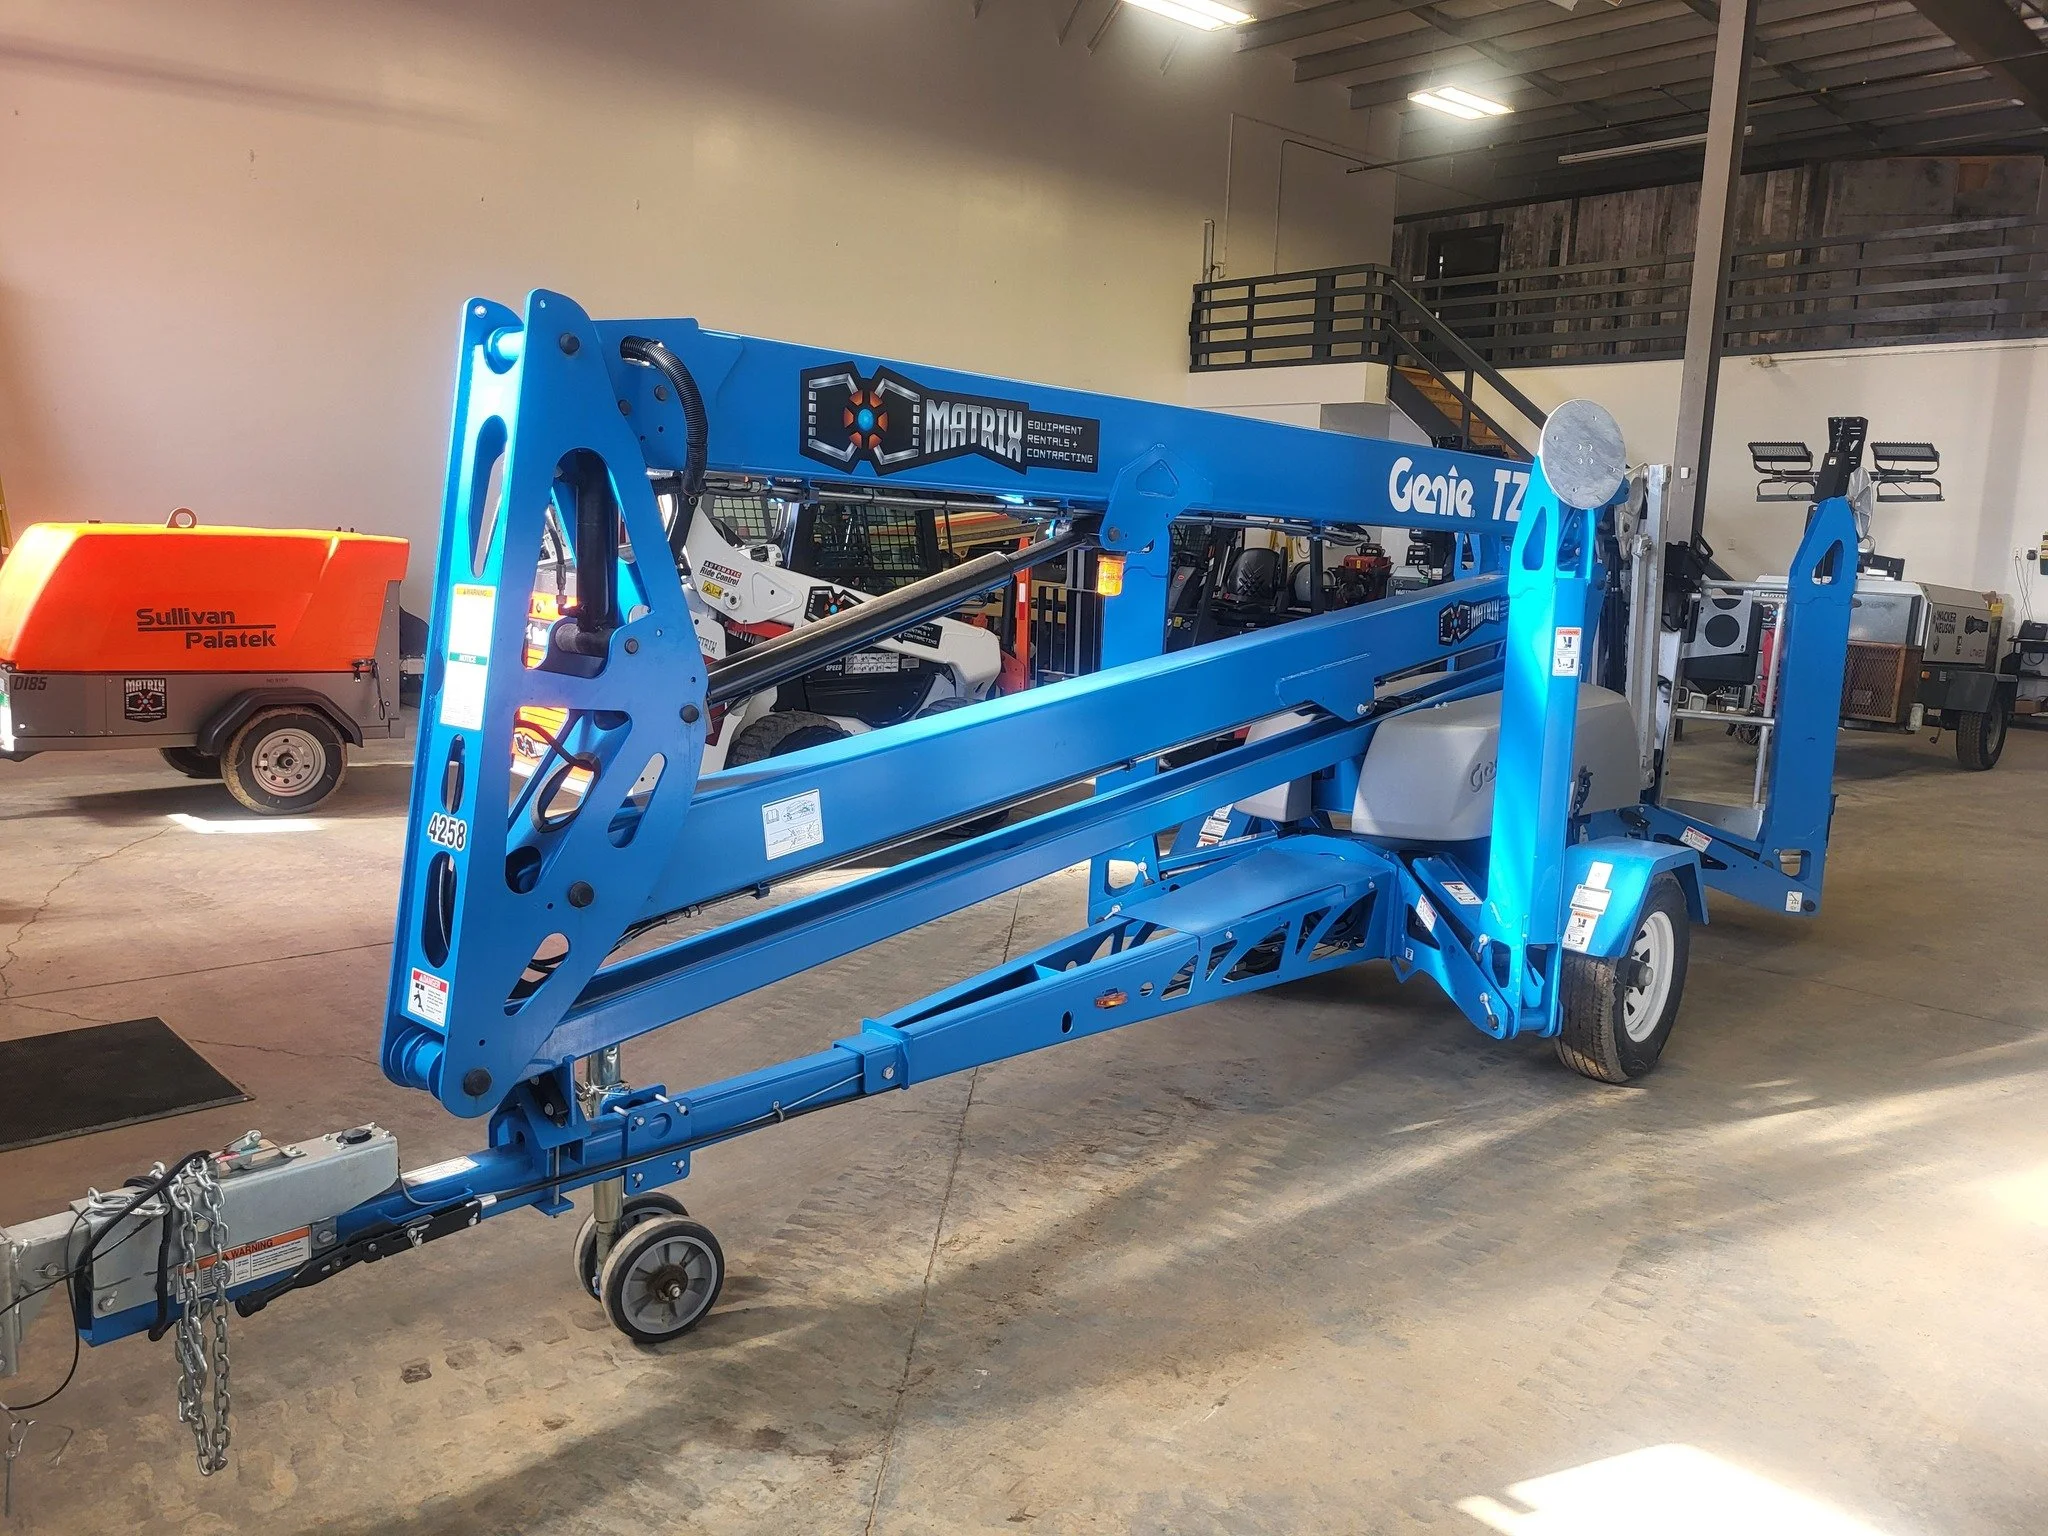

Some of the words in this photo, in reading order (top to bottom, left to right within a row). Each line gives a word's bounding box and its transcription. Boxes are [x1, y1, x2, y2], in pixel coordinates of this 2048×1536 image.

[925, 399, 1023, 463] MATRIX
[1027, 420, 1083, 435] EQUIPMENT
[1026, 434, 1070, 448] RENTALS
[1026, 448, 1094, 464] CONTRACTING
[1389, 457, 1475, 518] Genie
[700, 566, 716, 578] Ride
[715, 572, 740, 586] Control
[703, 561, 742, 579] AUTOMATIC
[136, 608, 236, 627] Sullivan
[1470, 599, 1500, 630] MATRIX
[185, 632, 277, 650] Palatek
[825, 664, 842, 672] SPEED
[126, 679, 165, 693] MATRIX
[1471, 760, 1496, 793] Ge
[429, 814, 466, 849] 4258
[231, 1239, 274, 1259] WARNING
